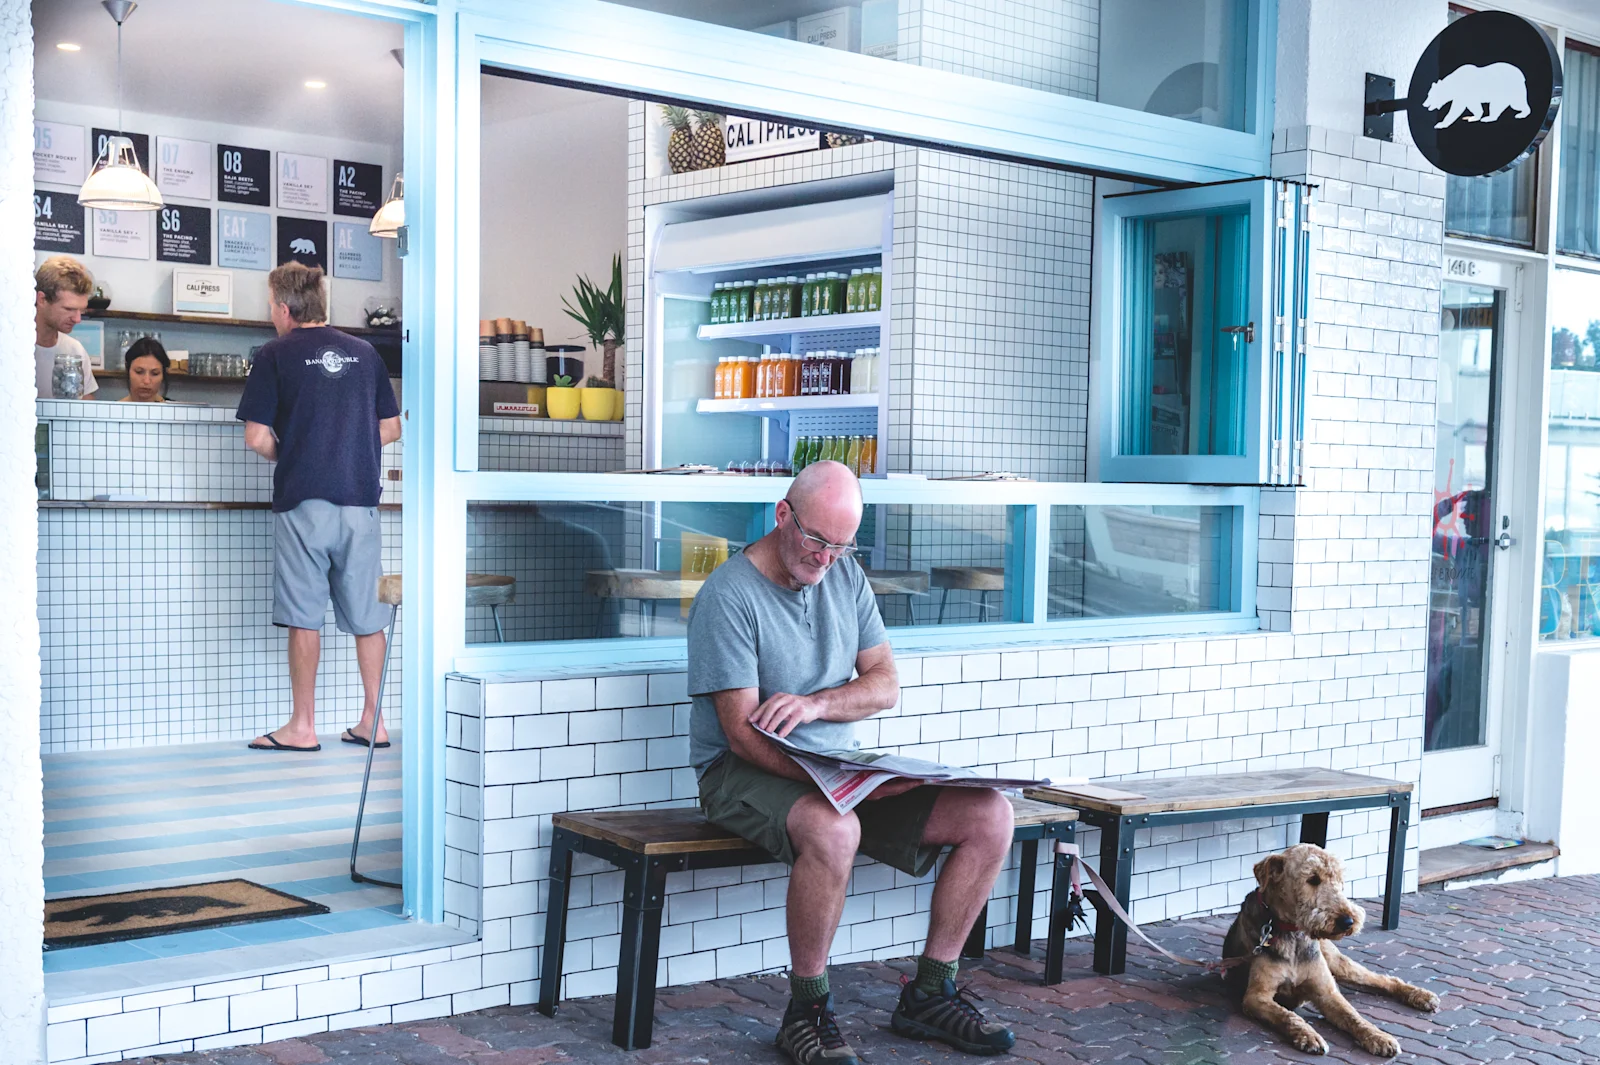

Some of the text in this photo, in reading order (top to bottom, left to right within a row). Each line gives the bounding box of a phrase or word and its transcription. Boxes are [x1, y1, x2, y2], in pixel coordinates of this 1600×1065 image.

[820, 29, 837, 40] PRESS
[162, 142, 180, 165] 07
[223, 150, 242, 174] 08
[282, 158, 300, 180] A1
[338, 165, 356, 188] A2
[34, 194, 53, 219] S4
[161, 208, 180, 232] S6
[223, 215, 247, 239] EAT
[339, 228, 353, 249] AE
